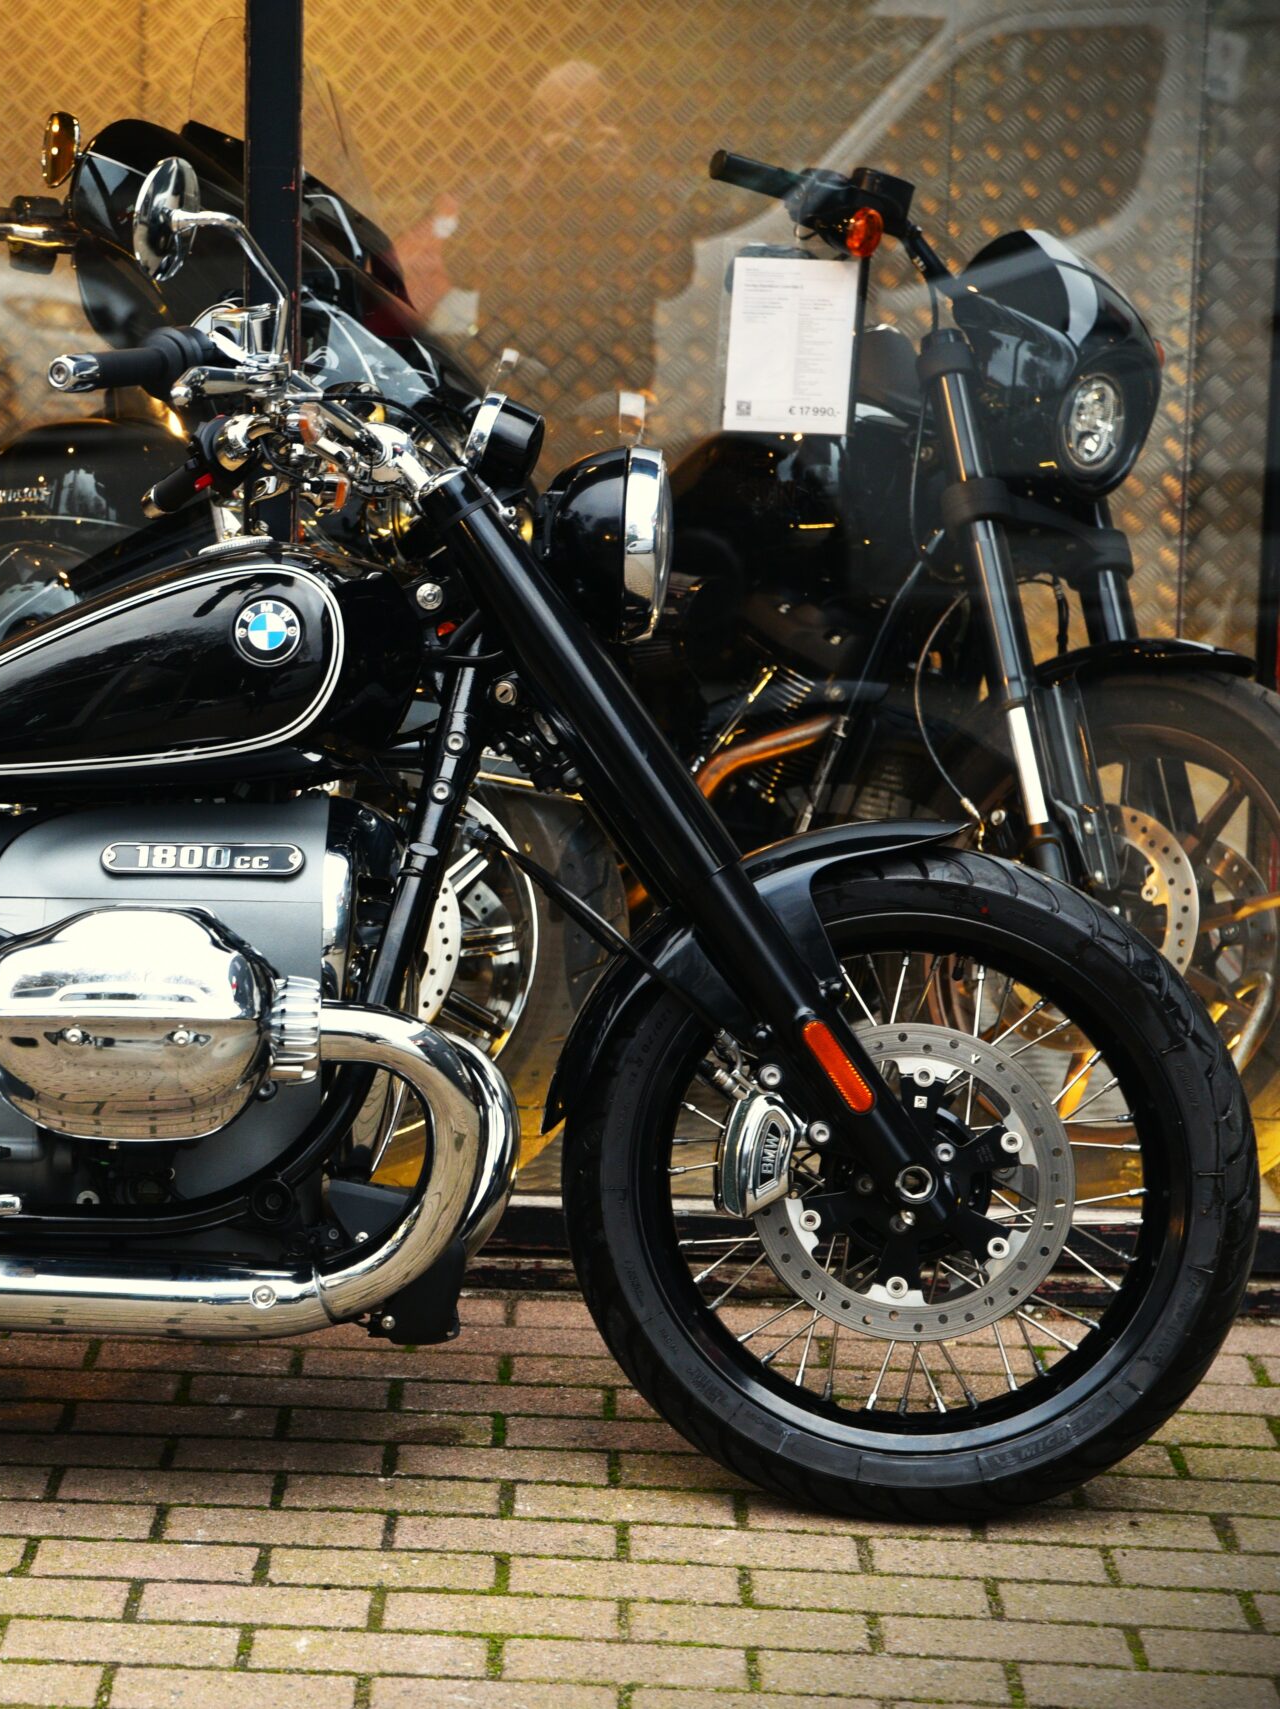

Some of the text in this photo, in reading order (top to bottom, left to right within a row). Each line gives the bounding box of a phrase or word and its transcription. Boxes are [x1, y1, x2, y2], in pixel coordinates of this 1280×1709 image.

[240, 602, 295, 623] BMW
[135, 845, 270, 869] 1800 cc
[761, 1132, 780, 1175] BMW
[1018, 1404, 1108, 1460] MICHELIN
